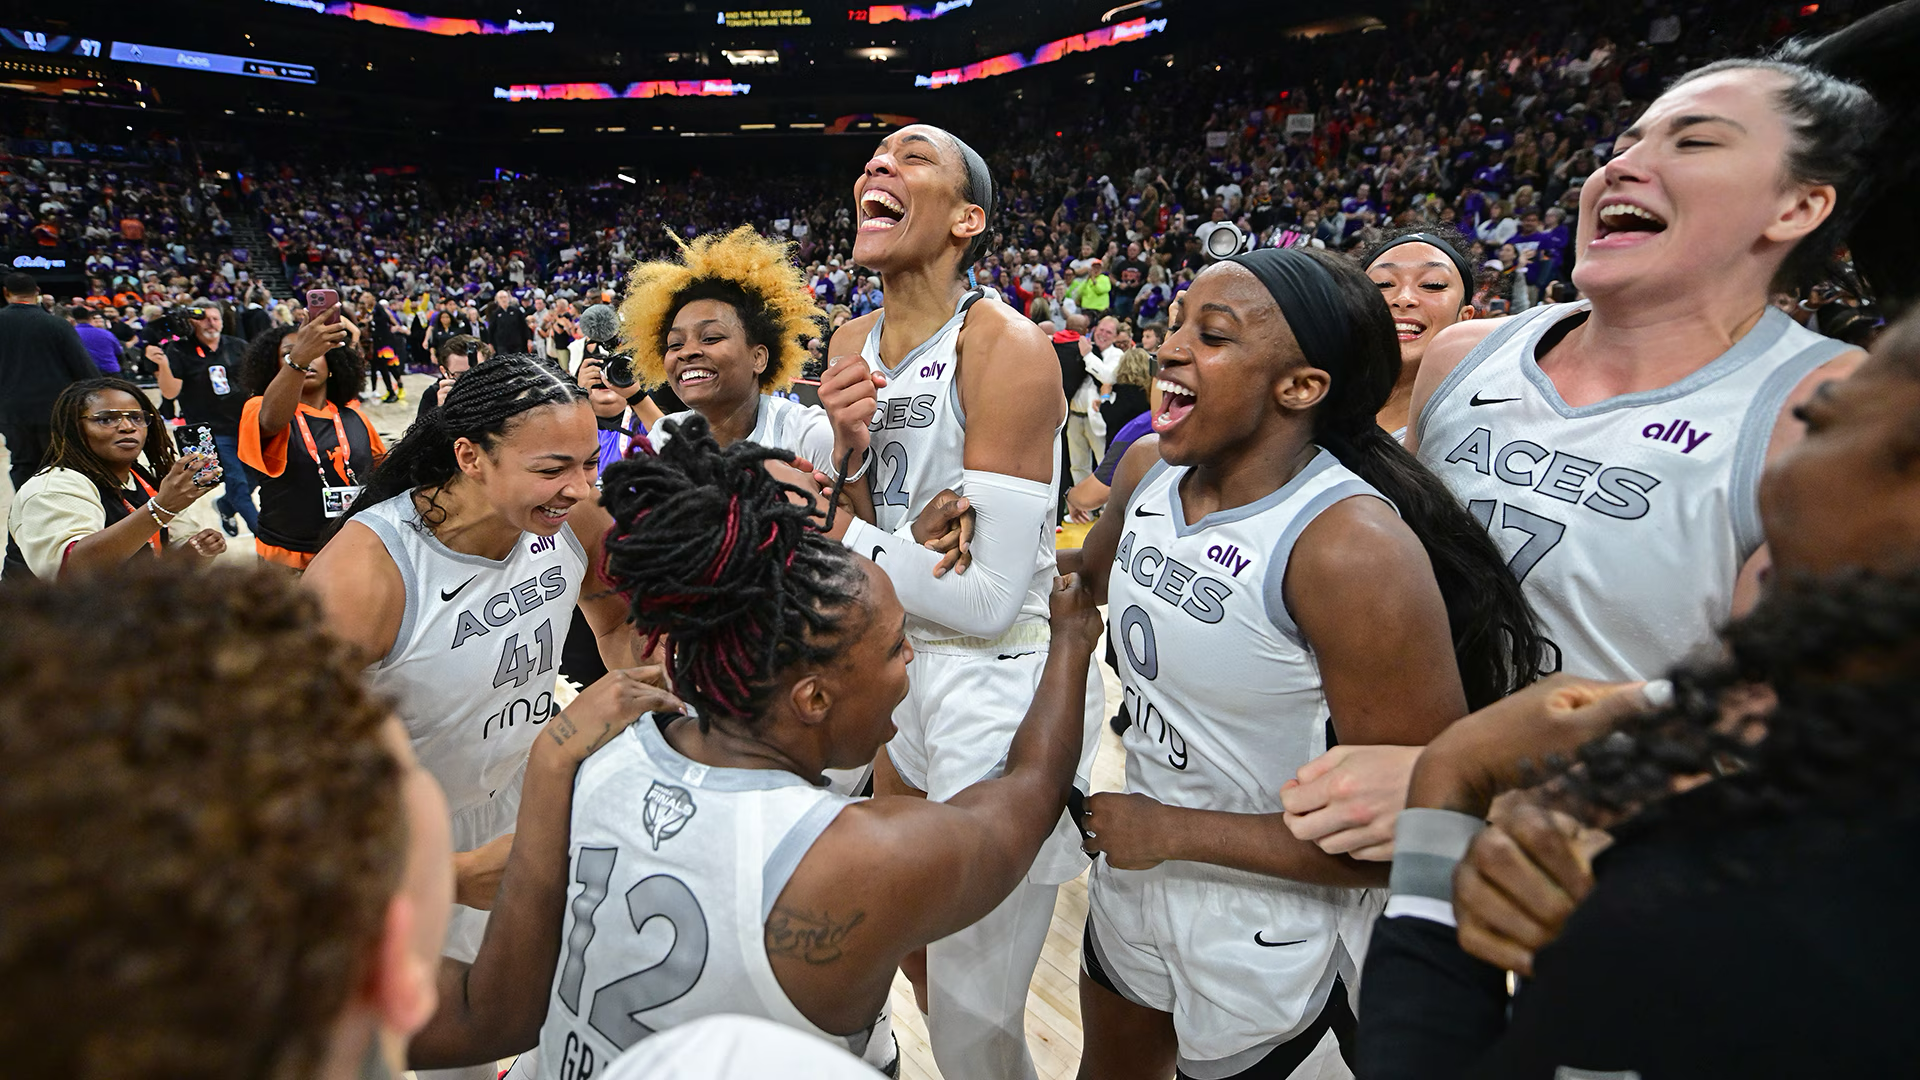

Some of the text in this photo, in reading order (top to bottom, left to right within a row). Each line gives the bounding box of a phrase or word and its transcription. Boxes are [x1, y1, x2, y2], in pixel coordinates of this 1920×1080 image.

[80, 39, 101, 58] 97
[177, 53, 210, 68] Aces
[920, 360, 947, 380] ally
[868, 394, 937, 432] CES
[1642, 419, 1712, 454] ally
[1445, 427, 1661, 520] ACES
[530, 535, 555, 554] ally
[1207, 544, 1252, 578] ally
[1114, 531, 1233, 624] ACES
[451, 565, 567, 650] ACES
[492, 618, 553, 689] 41
[1120, 604, 1158, 681] 0
[483, 691, 552, 740] ring
[1125, 685, 1188, 771] ring
[646, 789, 693, 817] FINALS
[558, 847, 709, 1051] 12
[560, 1031, 608, 1080] GR
